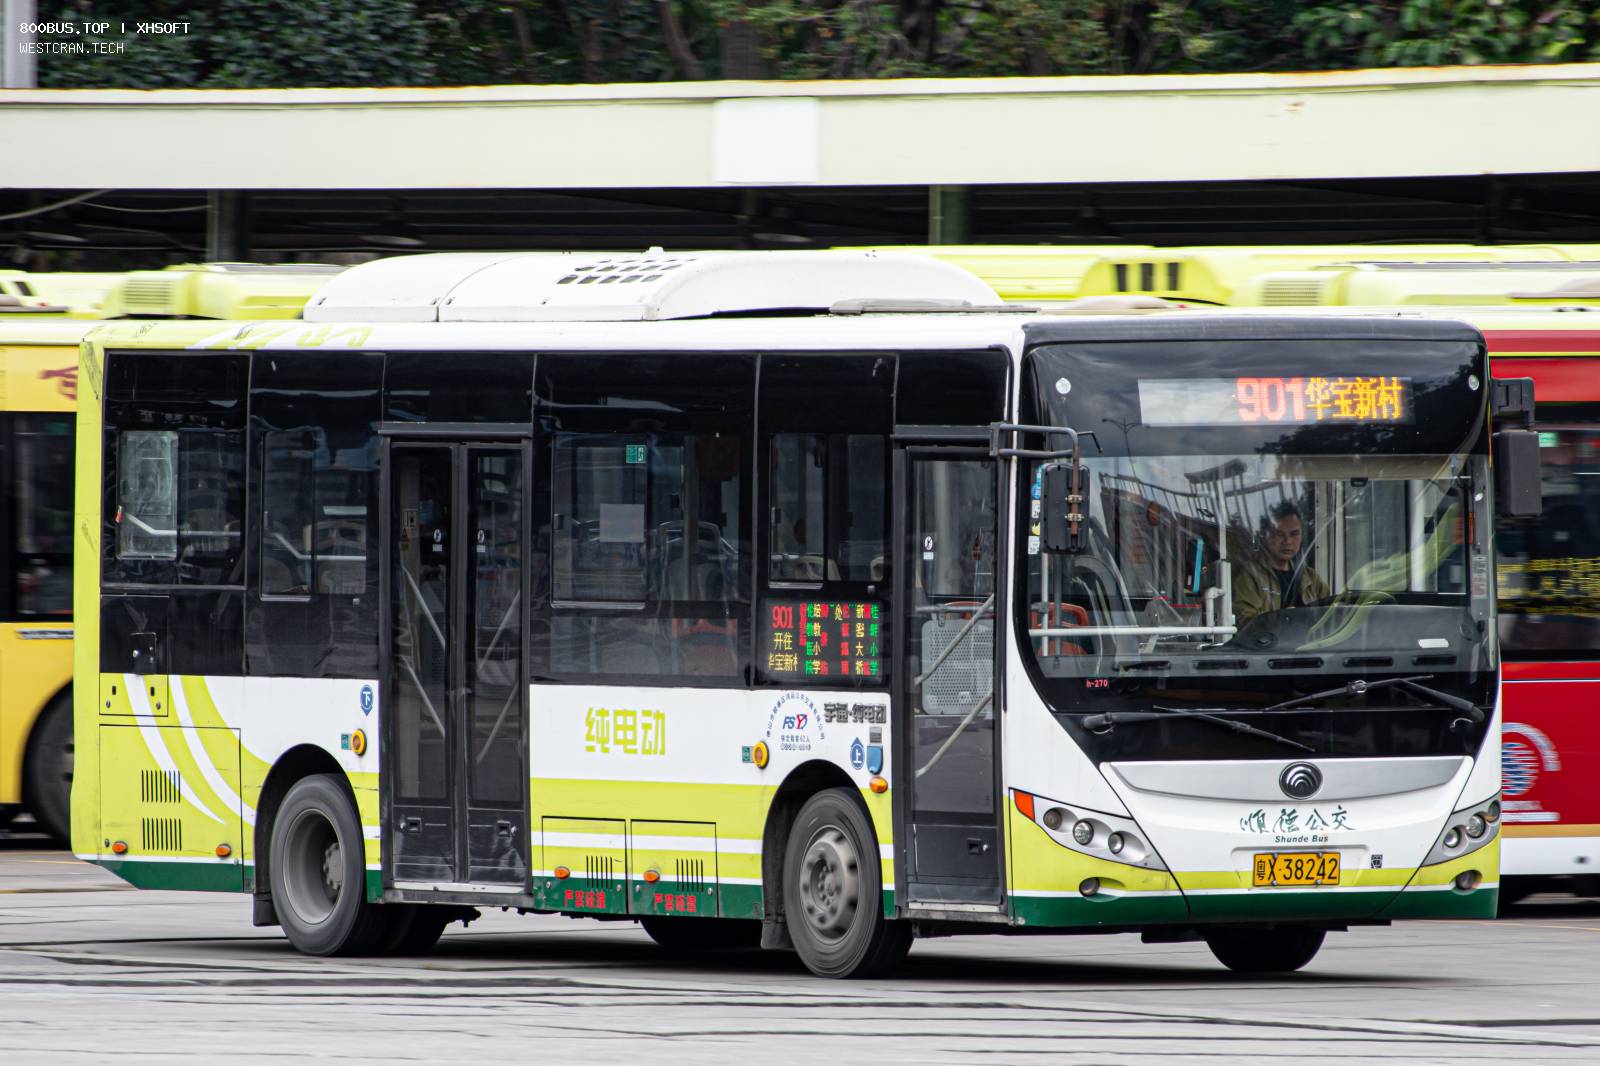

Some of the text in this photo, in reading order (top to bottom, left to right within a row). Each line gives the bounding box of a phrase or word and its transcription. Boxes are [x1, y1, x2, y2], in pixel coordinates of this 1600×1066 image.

[1305, 376, 1404, 421] 华宝新村
[771, 605, 793, 628] 901
[773, 632, 793, 651] 开往
[585, 707, 666, 756] 纯电动
[1275, 834, 1329, 843] Shunde Bus
